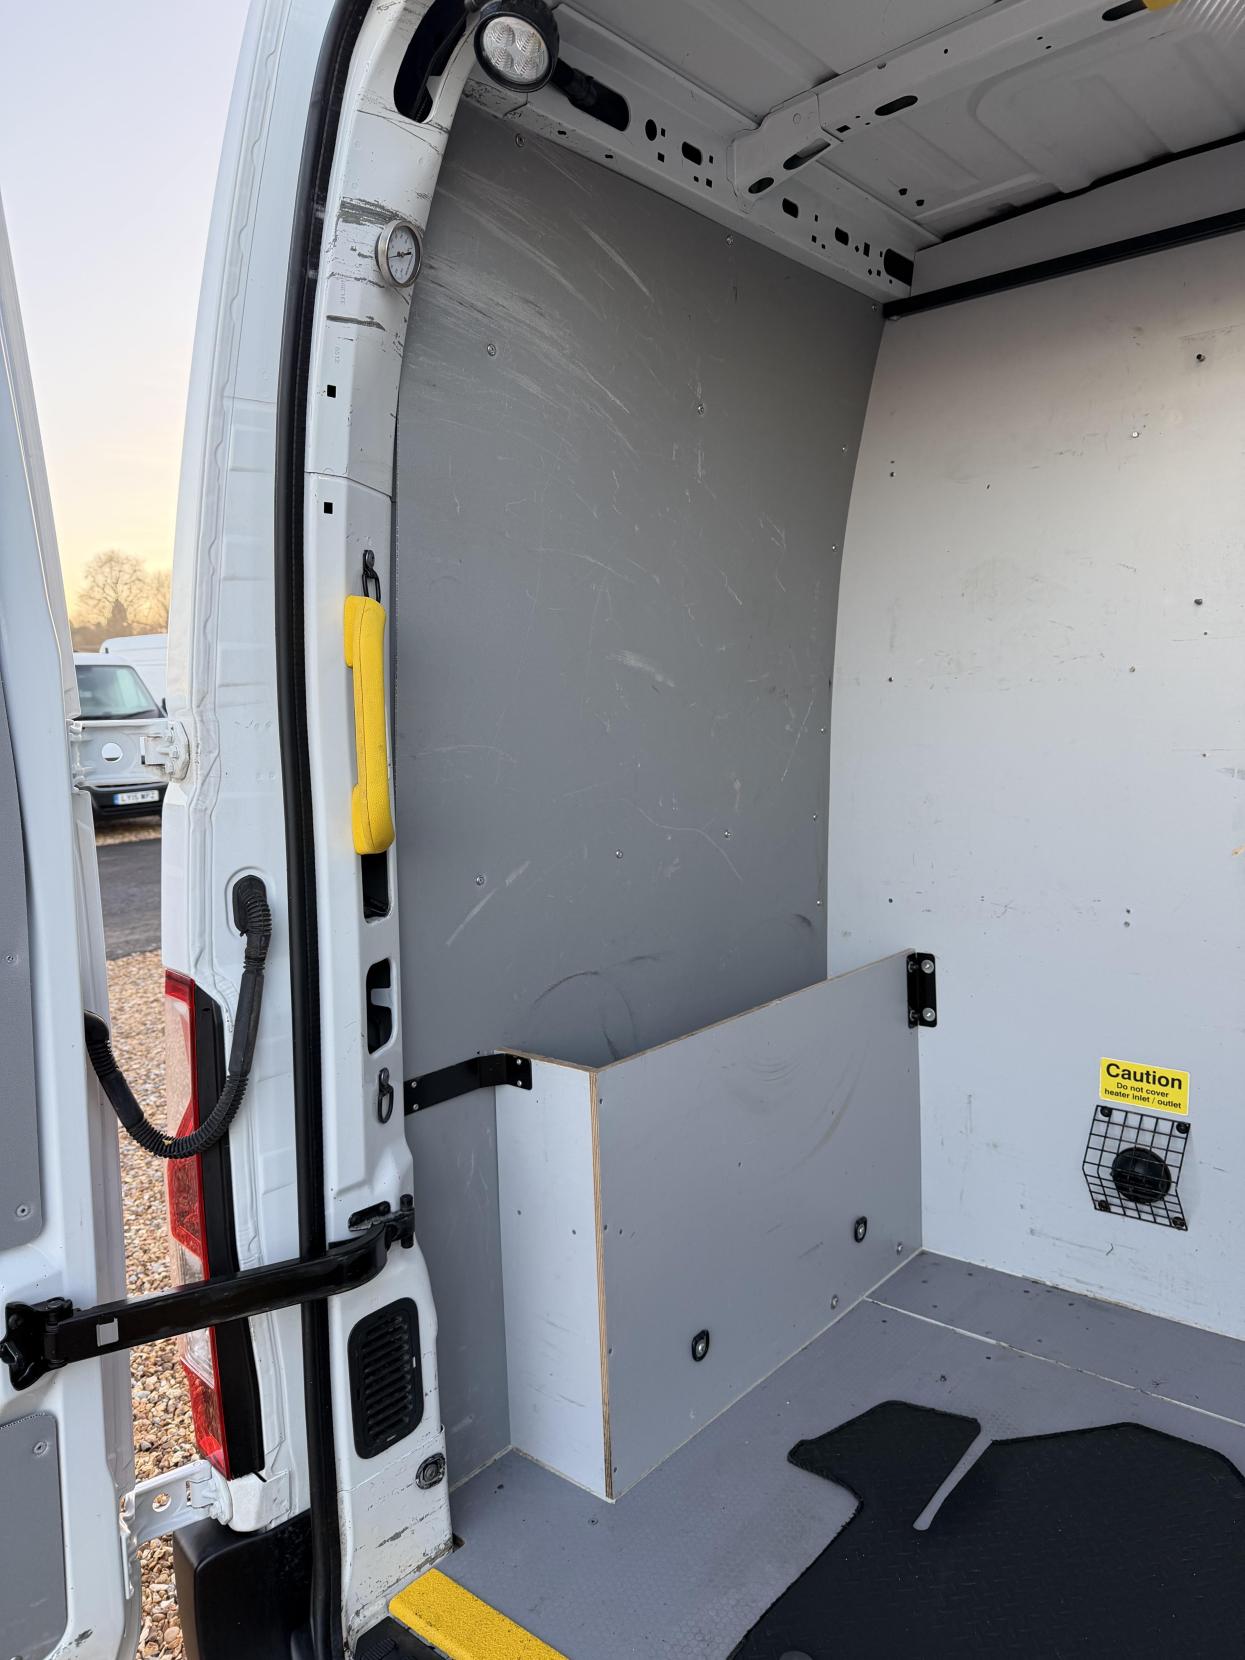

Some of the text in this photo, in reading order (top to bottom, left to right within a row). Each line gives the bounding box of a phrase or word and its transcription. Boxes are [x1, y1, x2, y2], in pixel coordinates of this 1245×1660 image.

[1106, 1063, 1182, 1090] Caution
[1104, 1088, 1181, 1109] heater inlet / outlet
[1116, 1082, 1169, 1098] Do not cover
